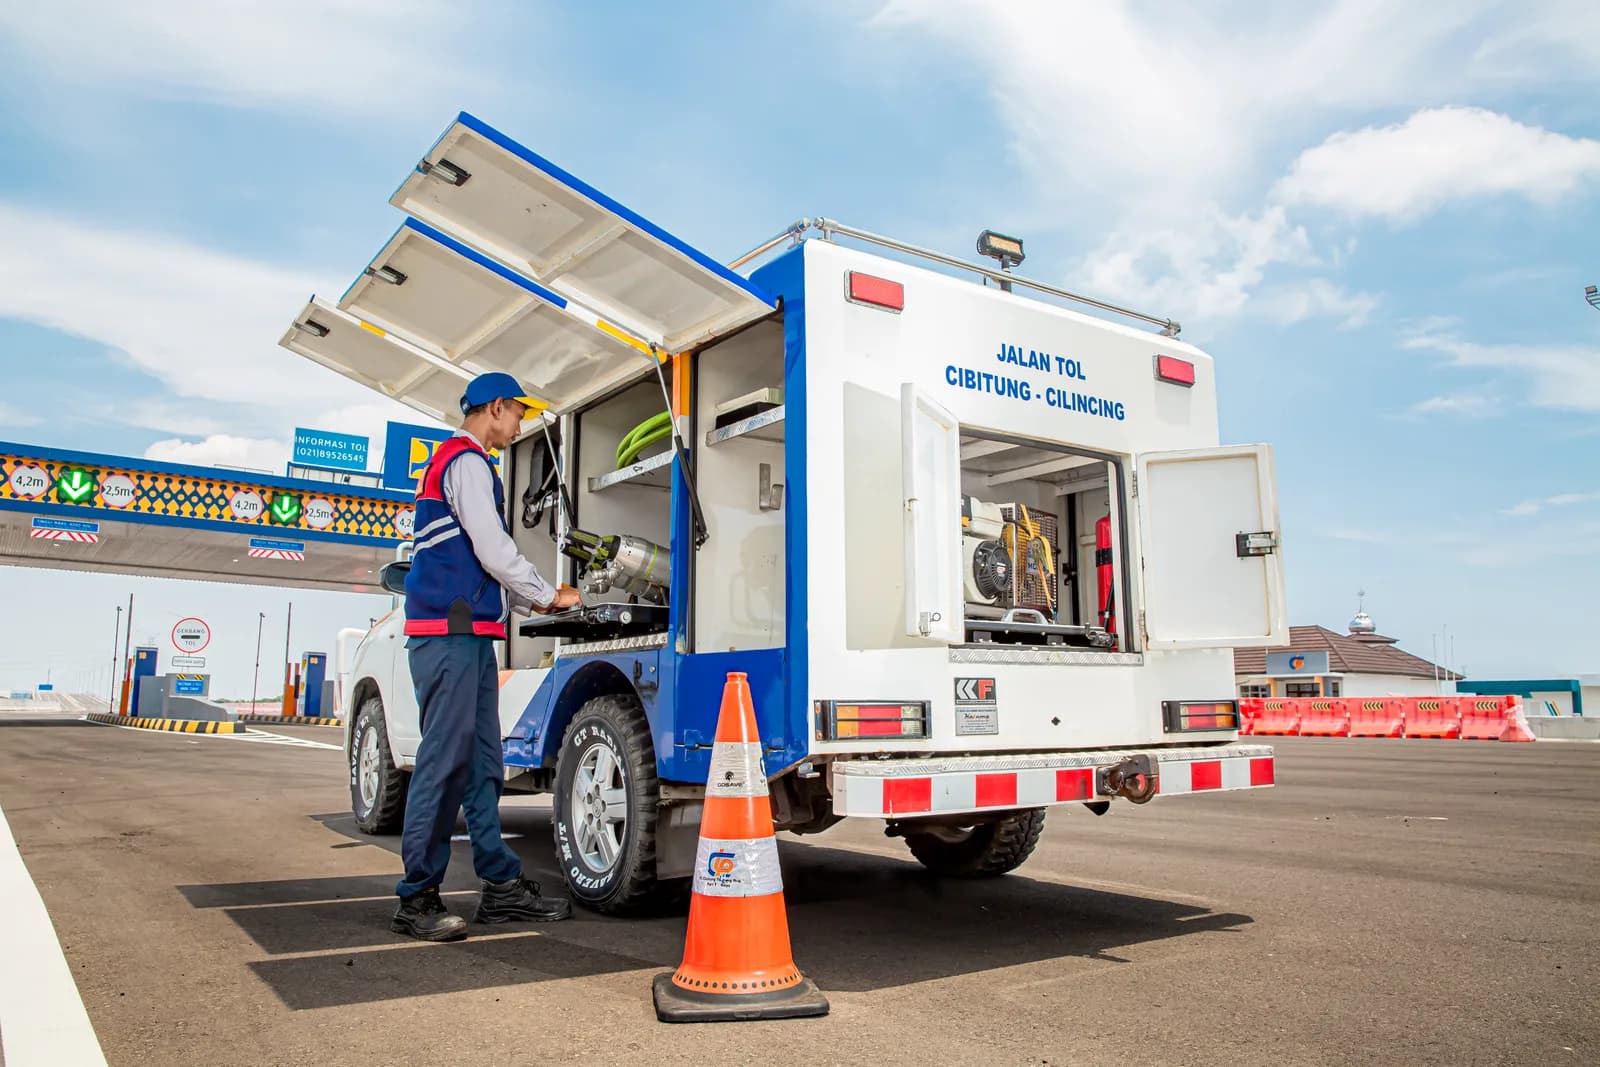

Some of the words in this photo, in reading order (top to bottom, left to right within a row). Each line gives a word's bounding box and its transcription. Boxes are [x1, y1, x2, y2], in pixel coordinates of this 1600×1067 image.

[997, 343, 1050, 372] JALAN
[1055, 356, 1086, 380] TOL
[945, 365, 1031, 401] CIBITUNG
[1046, 387, 1125, 421] CILINCING
[295, 436, 347, 449] INFORMASI
[351, 442, 367, 452] TOL
[296, 447, 364, 463] (021)89526545
[15, 475, 44, 488] 4,2m
[105, 485, 131, 497] 2,5m
[235, 500, 258, 511] 4,2m
[308, 507, 330, 519] 2,5m
[399, 517, 415, 529] 4,2
[574, 727, 587, 747] GT
